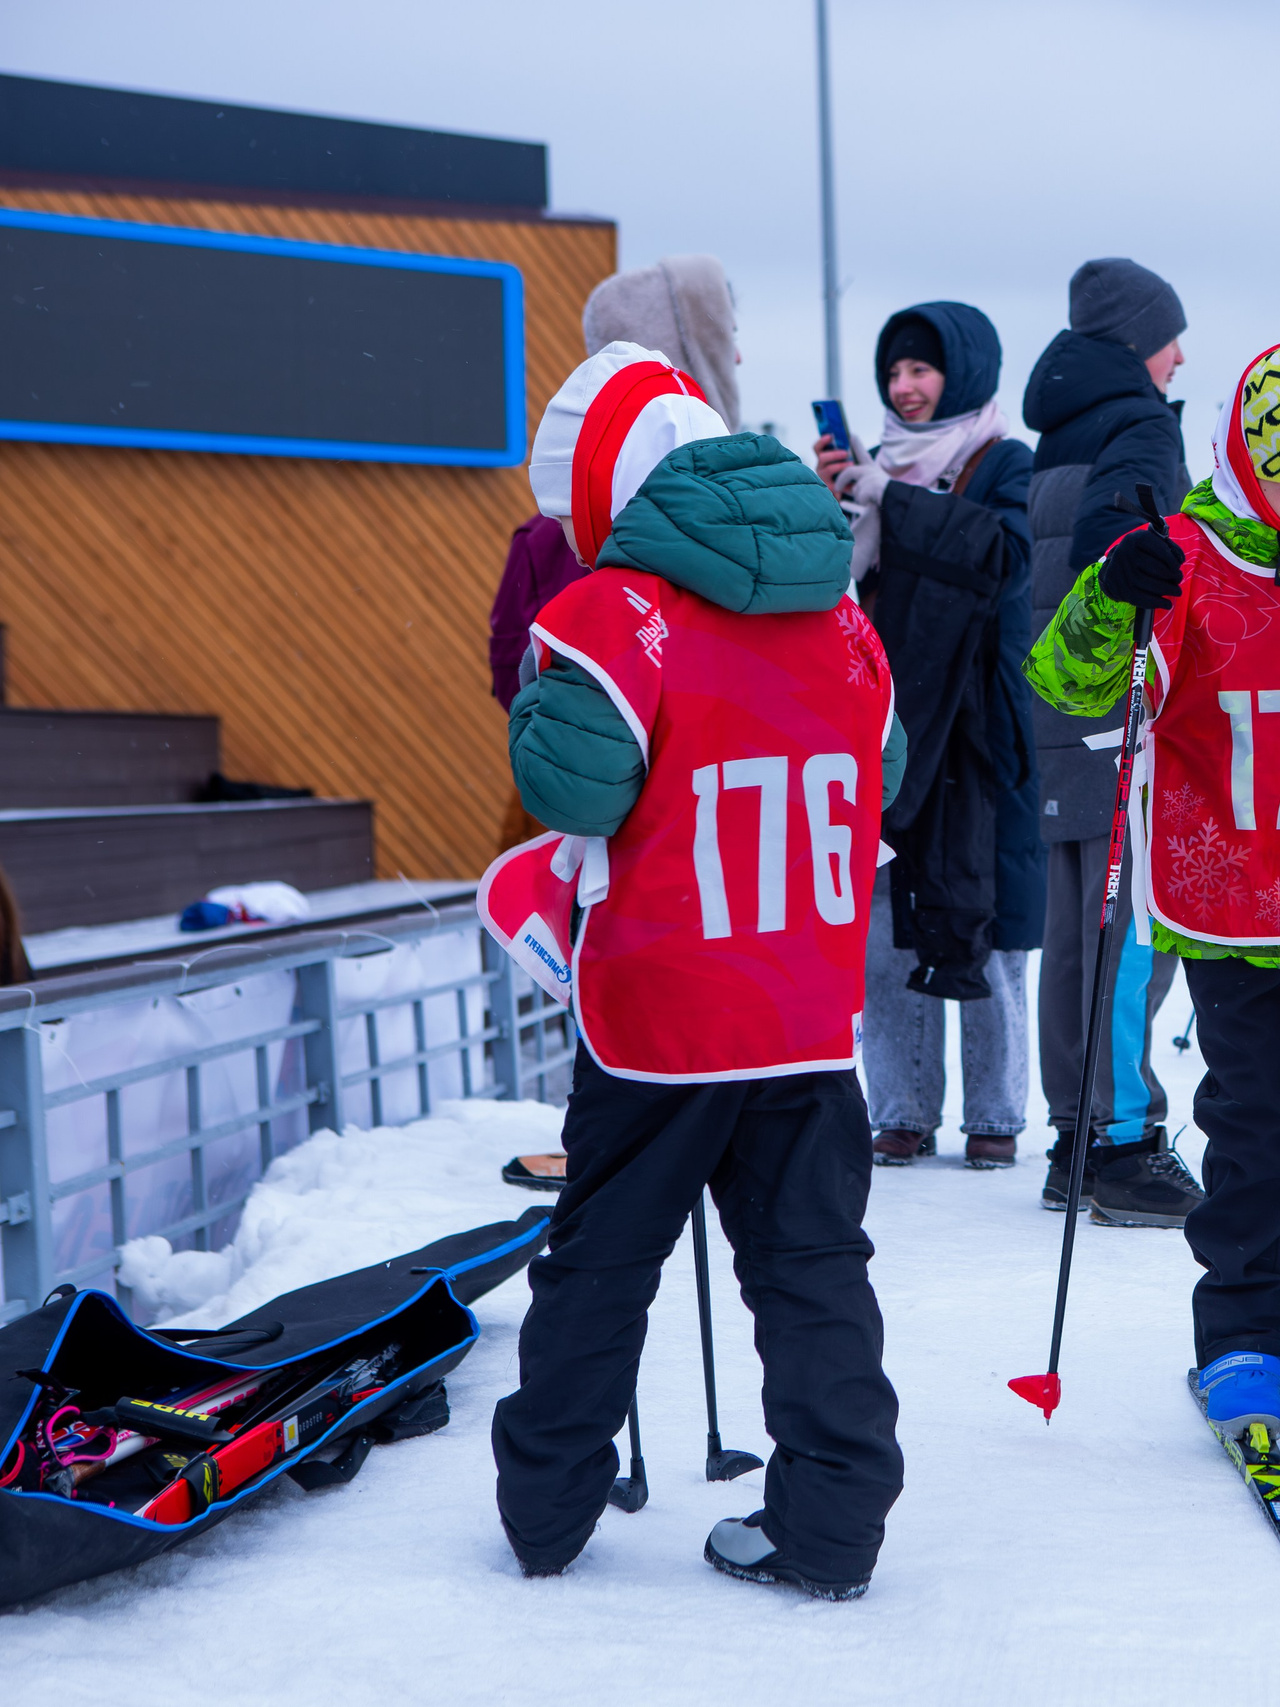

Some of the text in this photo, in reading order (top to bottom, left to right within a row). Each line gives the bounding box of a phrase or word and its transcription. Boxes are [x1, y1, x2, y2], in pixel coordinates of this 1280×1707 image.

[1131, 648, 1148, 689] TREK
[1117, 753, 1134, 801] TOP
[692, 753, 858, 940] 176
[1105, 863, 1122, 900] TREK
[1205, 1355, 1261, 1378] SPINE
